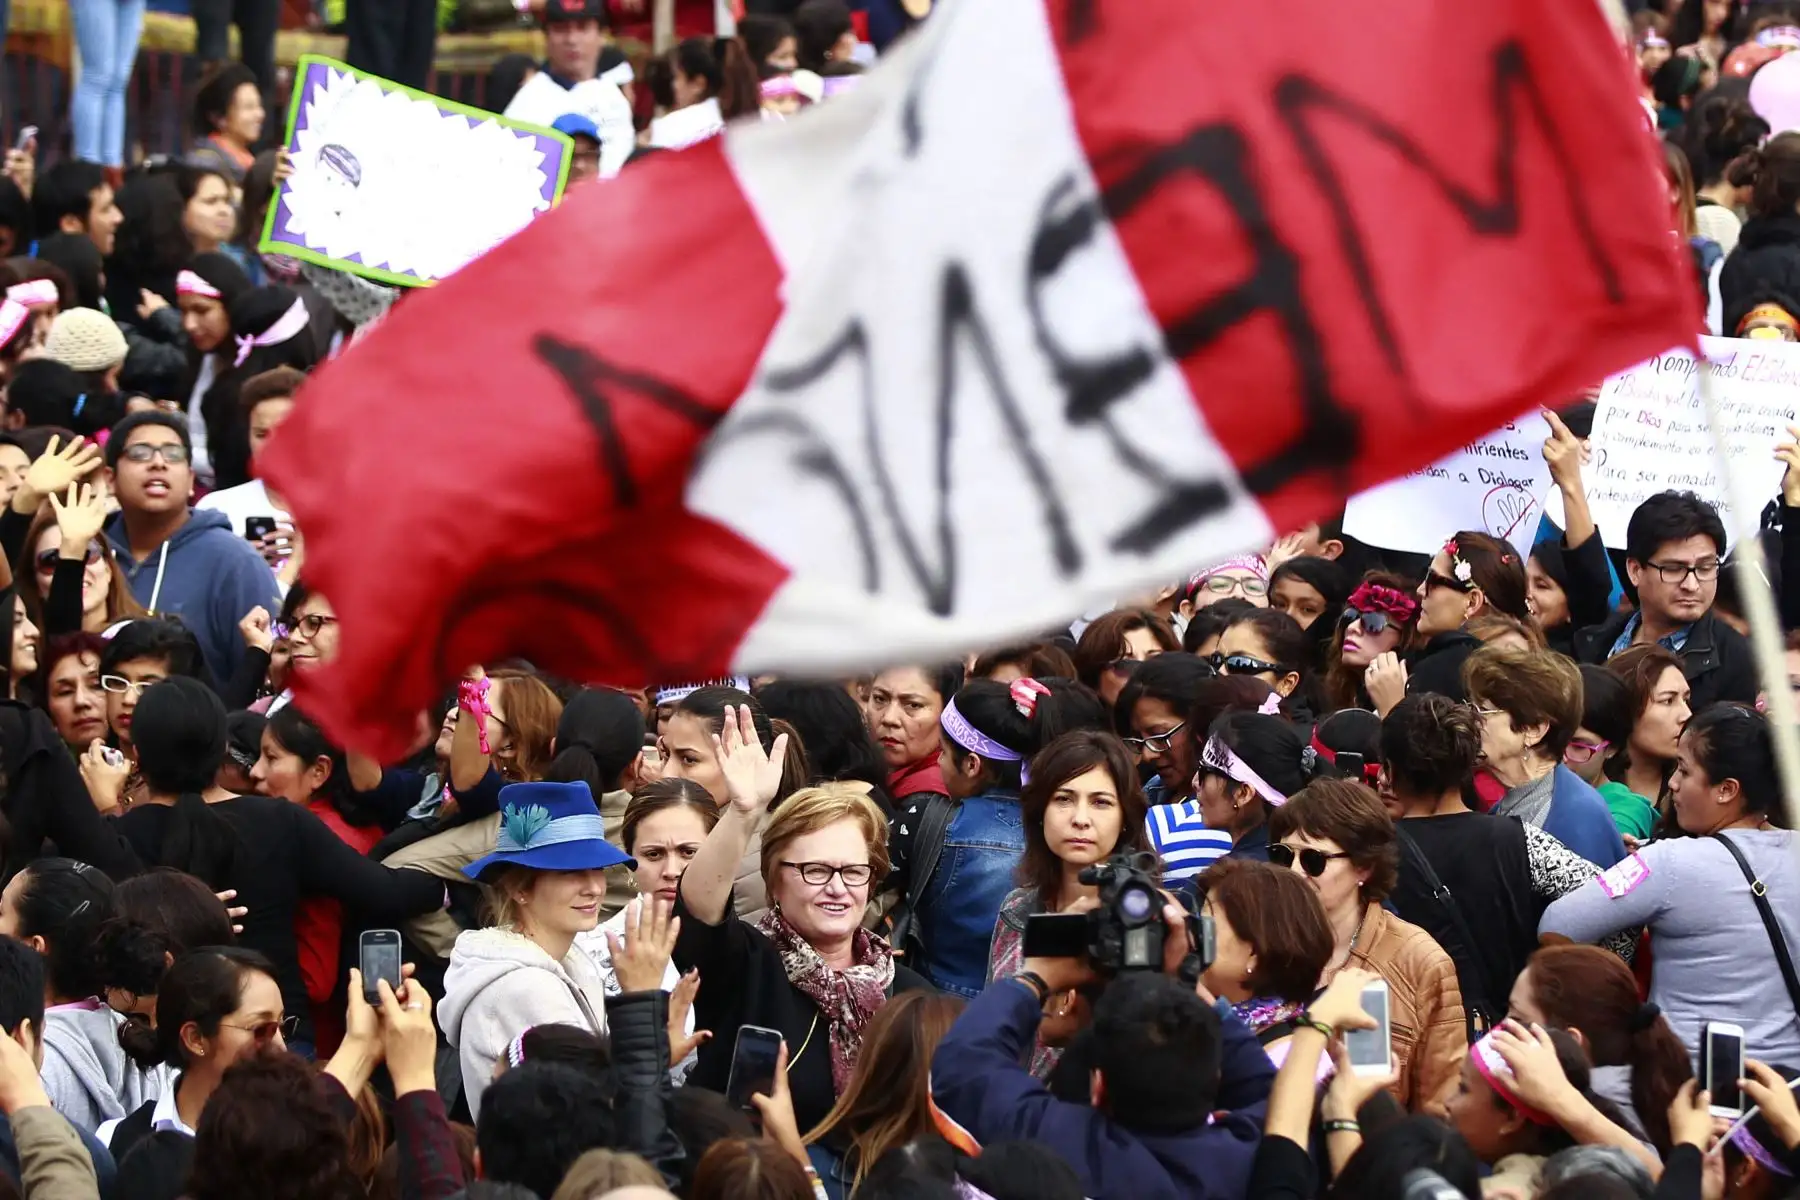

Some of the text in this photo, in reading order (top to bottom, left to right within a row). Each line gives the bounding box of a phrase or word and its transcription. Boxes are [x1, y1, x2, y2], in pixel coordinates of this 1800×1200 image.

[1648, 352, 1738, 385] ompndo
[1605, 406, 1631, 425] por
[1637, 410, 1661, 429] Dios
[1666, 420, 1691, 435] para
[1458, 472, 1470, 484] a
[1477, 467, 1535, 493] Dialogar
[1596, 448, 1716, 487] Para ser amada
